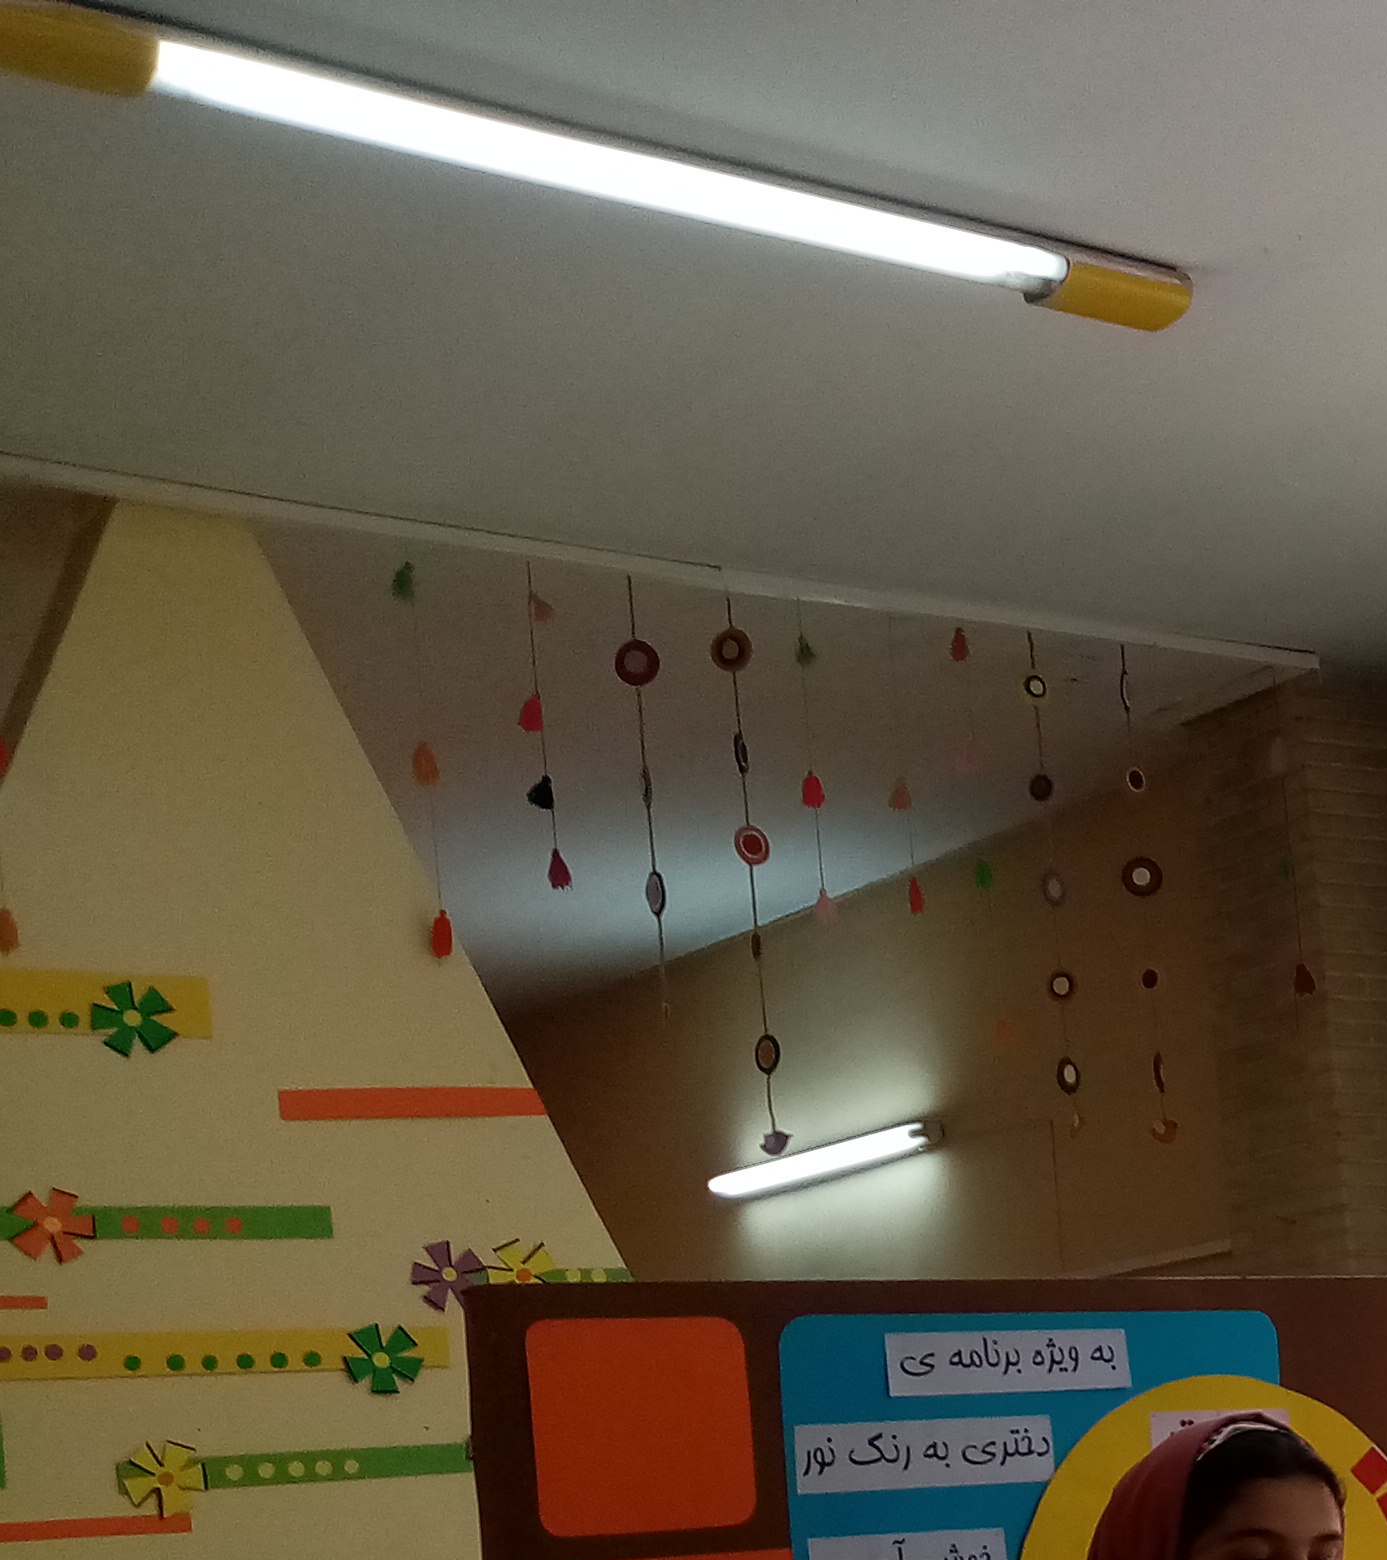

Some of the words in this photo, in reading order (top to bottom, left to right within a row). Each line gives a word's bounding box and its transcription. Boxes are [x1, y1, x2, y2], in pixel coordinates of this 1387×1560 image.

[898, 1351, 937, 1378] ی
[947, 1336, 1022, 1376] برنامه
[1031, 1337, 1080, 1374] ویژه
[1089, 1343, 1117, 1372] به
[801, 1435, 838, 1477] نور
[922, 1440, 951, 1469] به
[960, 1426, 1051, 1464] دختری
